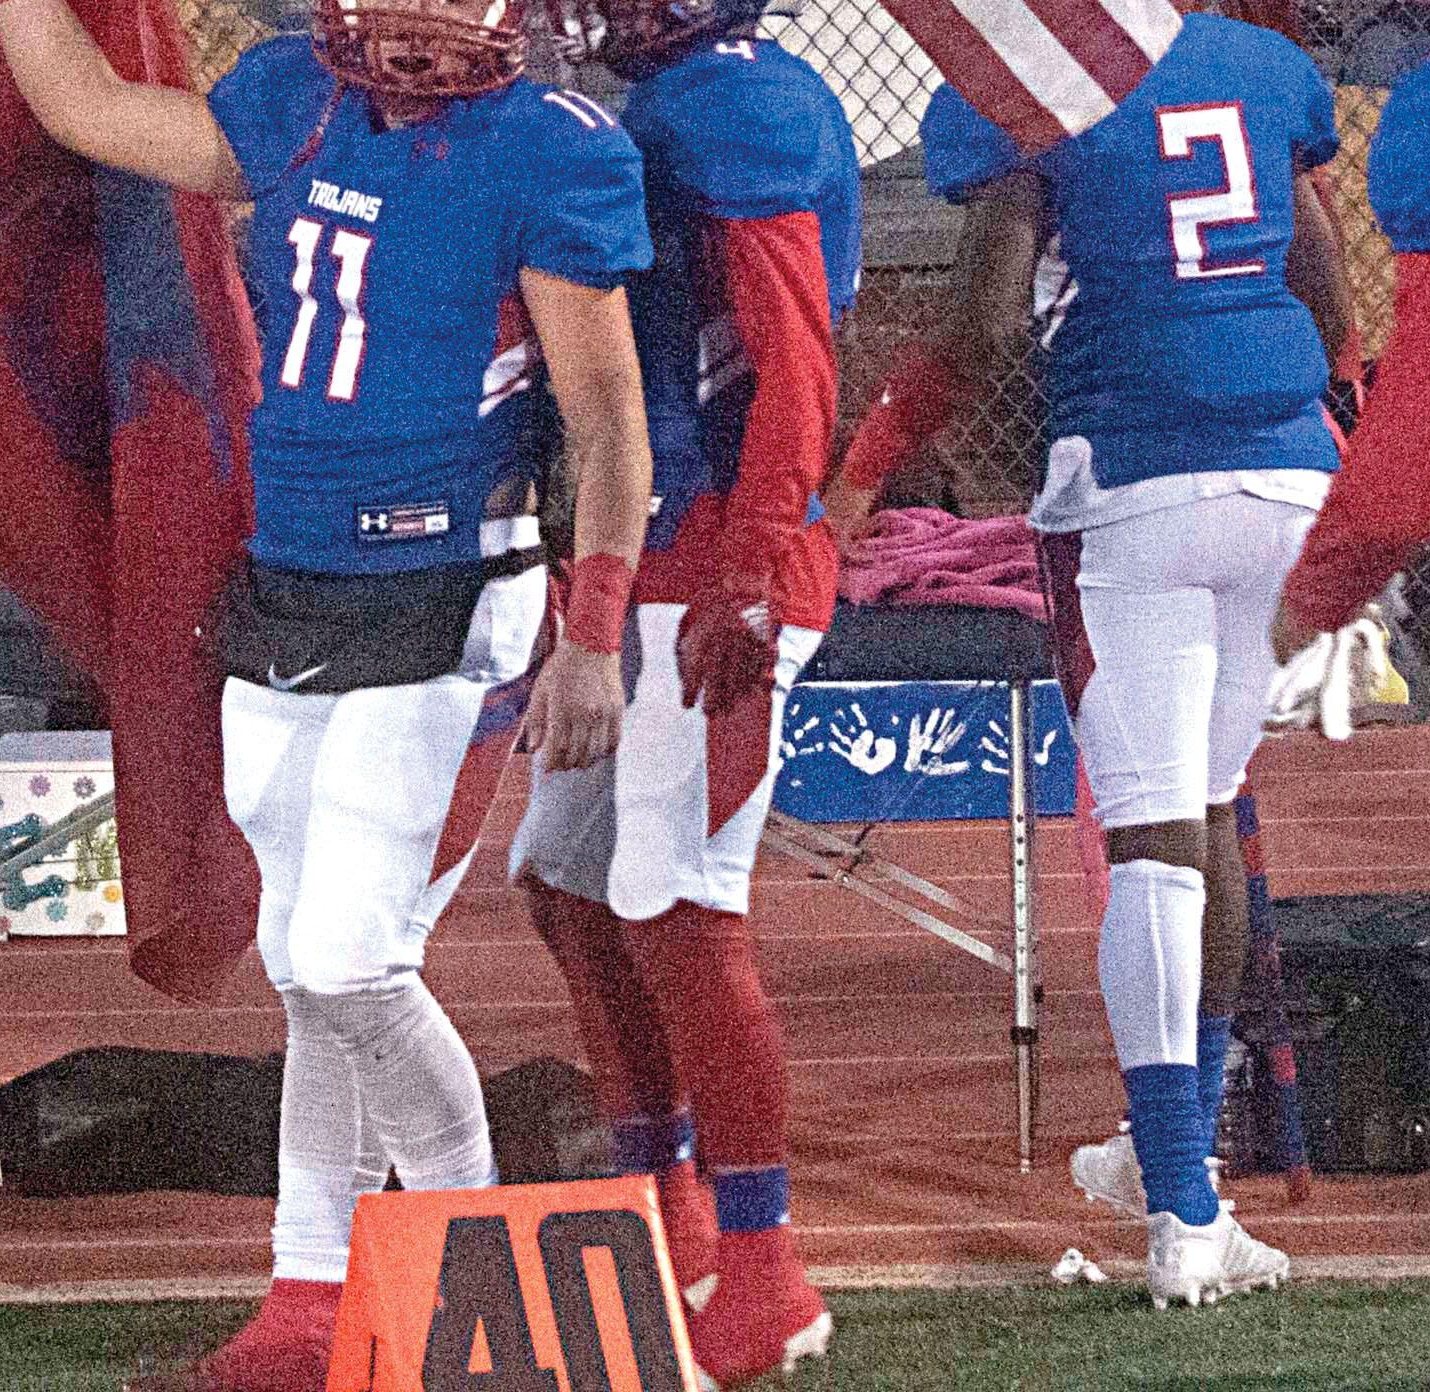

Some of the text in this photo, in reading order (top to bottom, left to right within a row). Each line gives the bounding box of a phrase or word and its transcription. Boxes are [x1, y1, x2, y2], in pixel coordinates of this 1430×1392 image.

[542, 89, 615, 129] 11
[1155, 101, 1265, 283] 2
[307, 179, 382, 222] TROJANS
[279, 215, 374, 404] 11
[421, 1209, 687, 1392] 40
